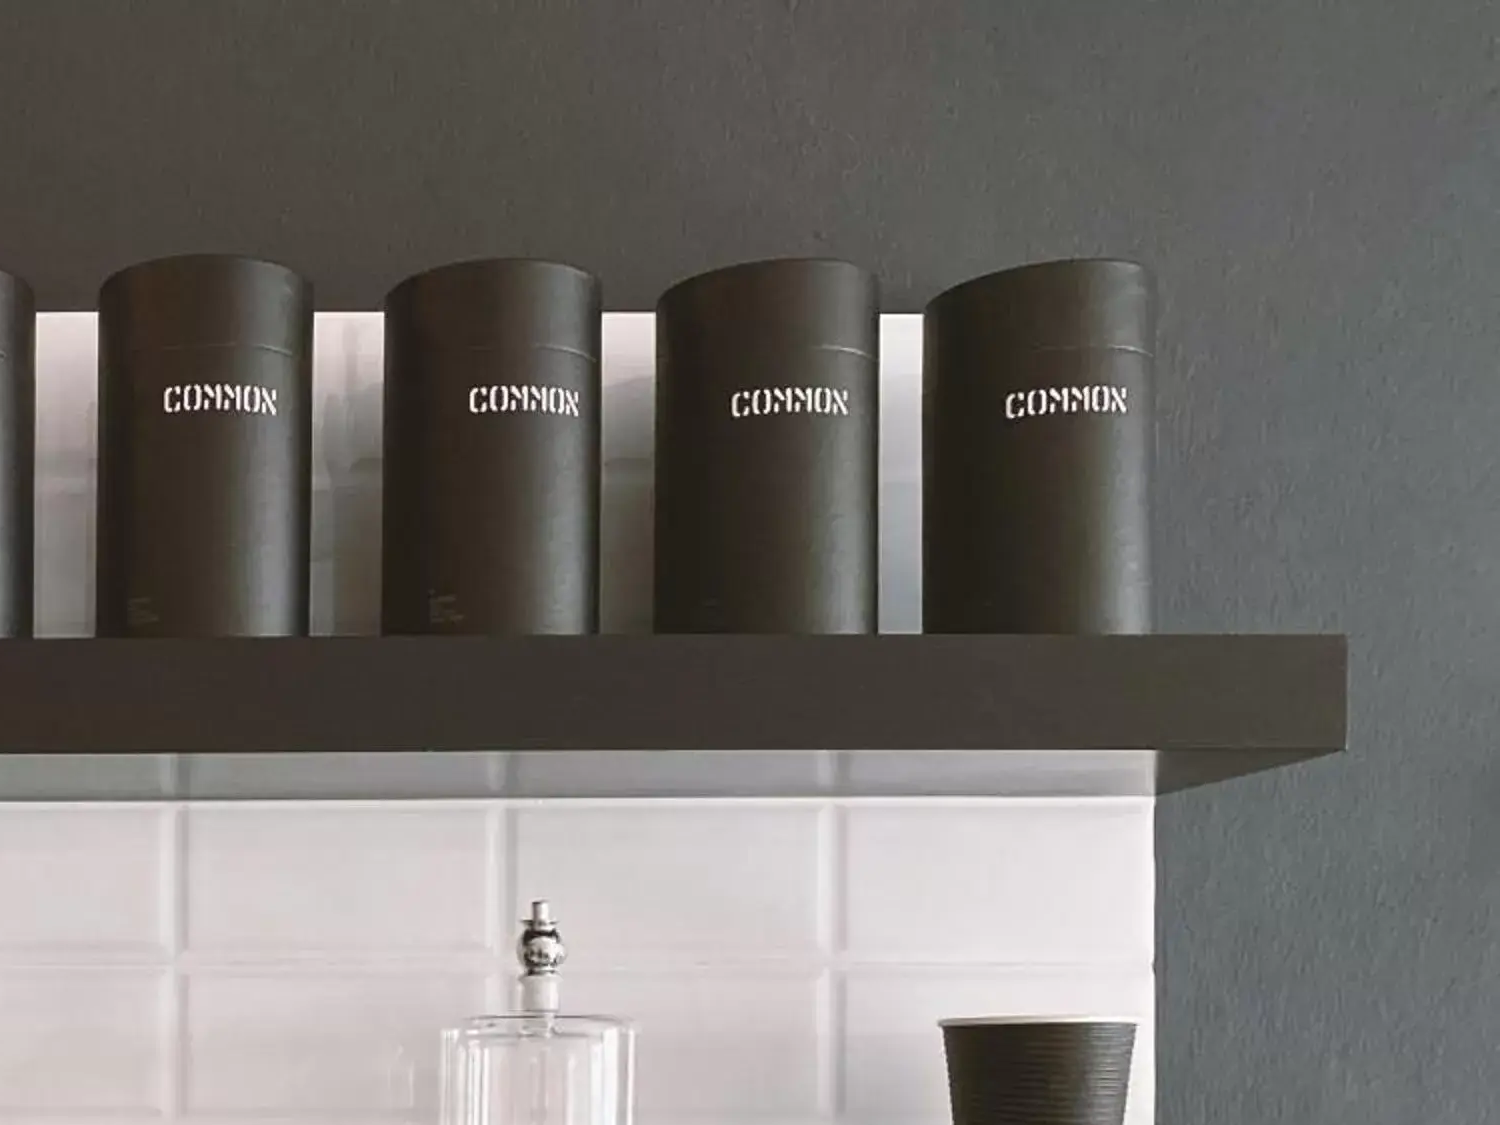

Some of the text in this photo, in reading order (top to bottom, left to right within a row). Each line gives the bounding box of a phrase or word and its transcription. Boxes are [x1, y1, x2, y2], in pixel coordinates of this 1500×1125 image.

[162, 383, 278, 417] COMMON
[468, 385, 580, 418] COMMON
[730, 386, 850, 418] COMMON
[1004, 385, 1128, 419] COMMON
